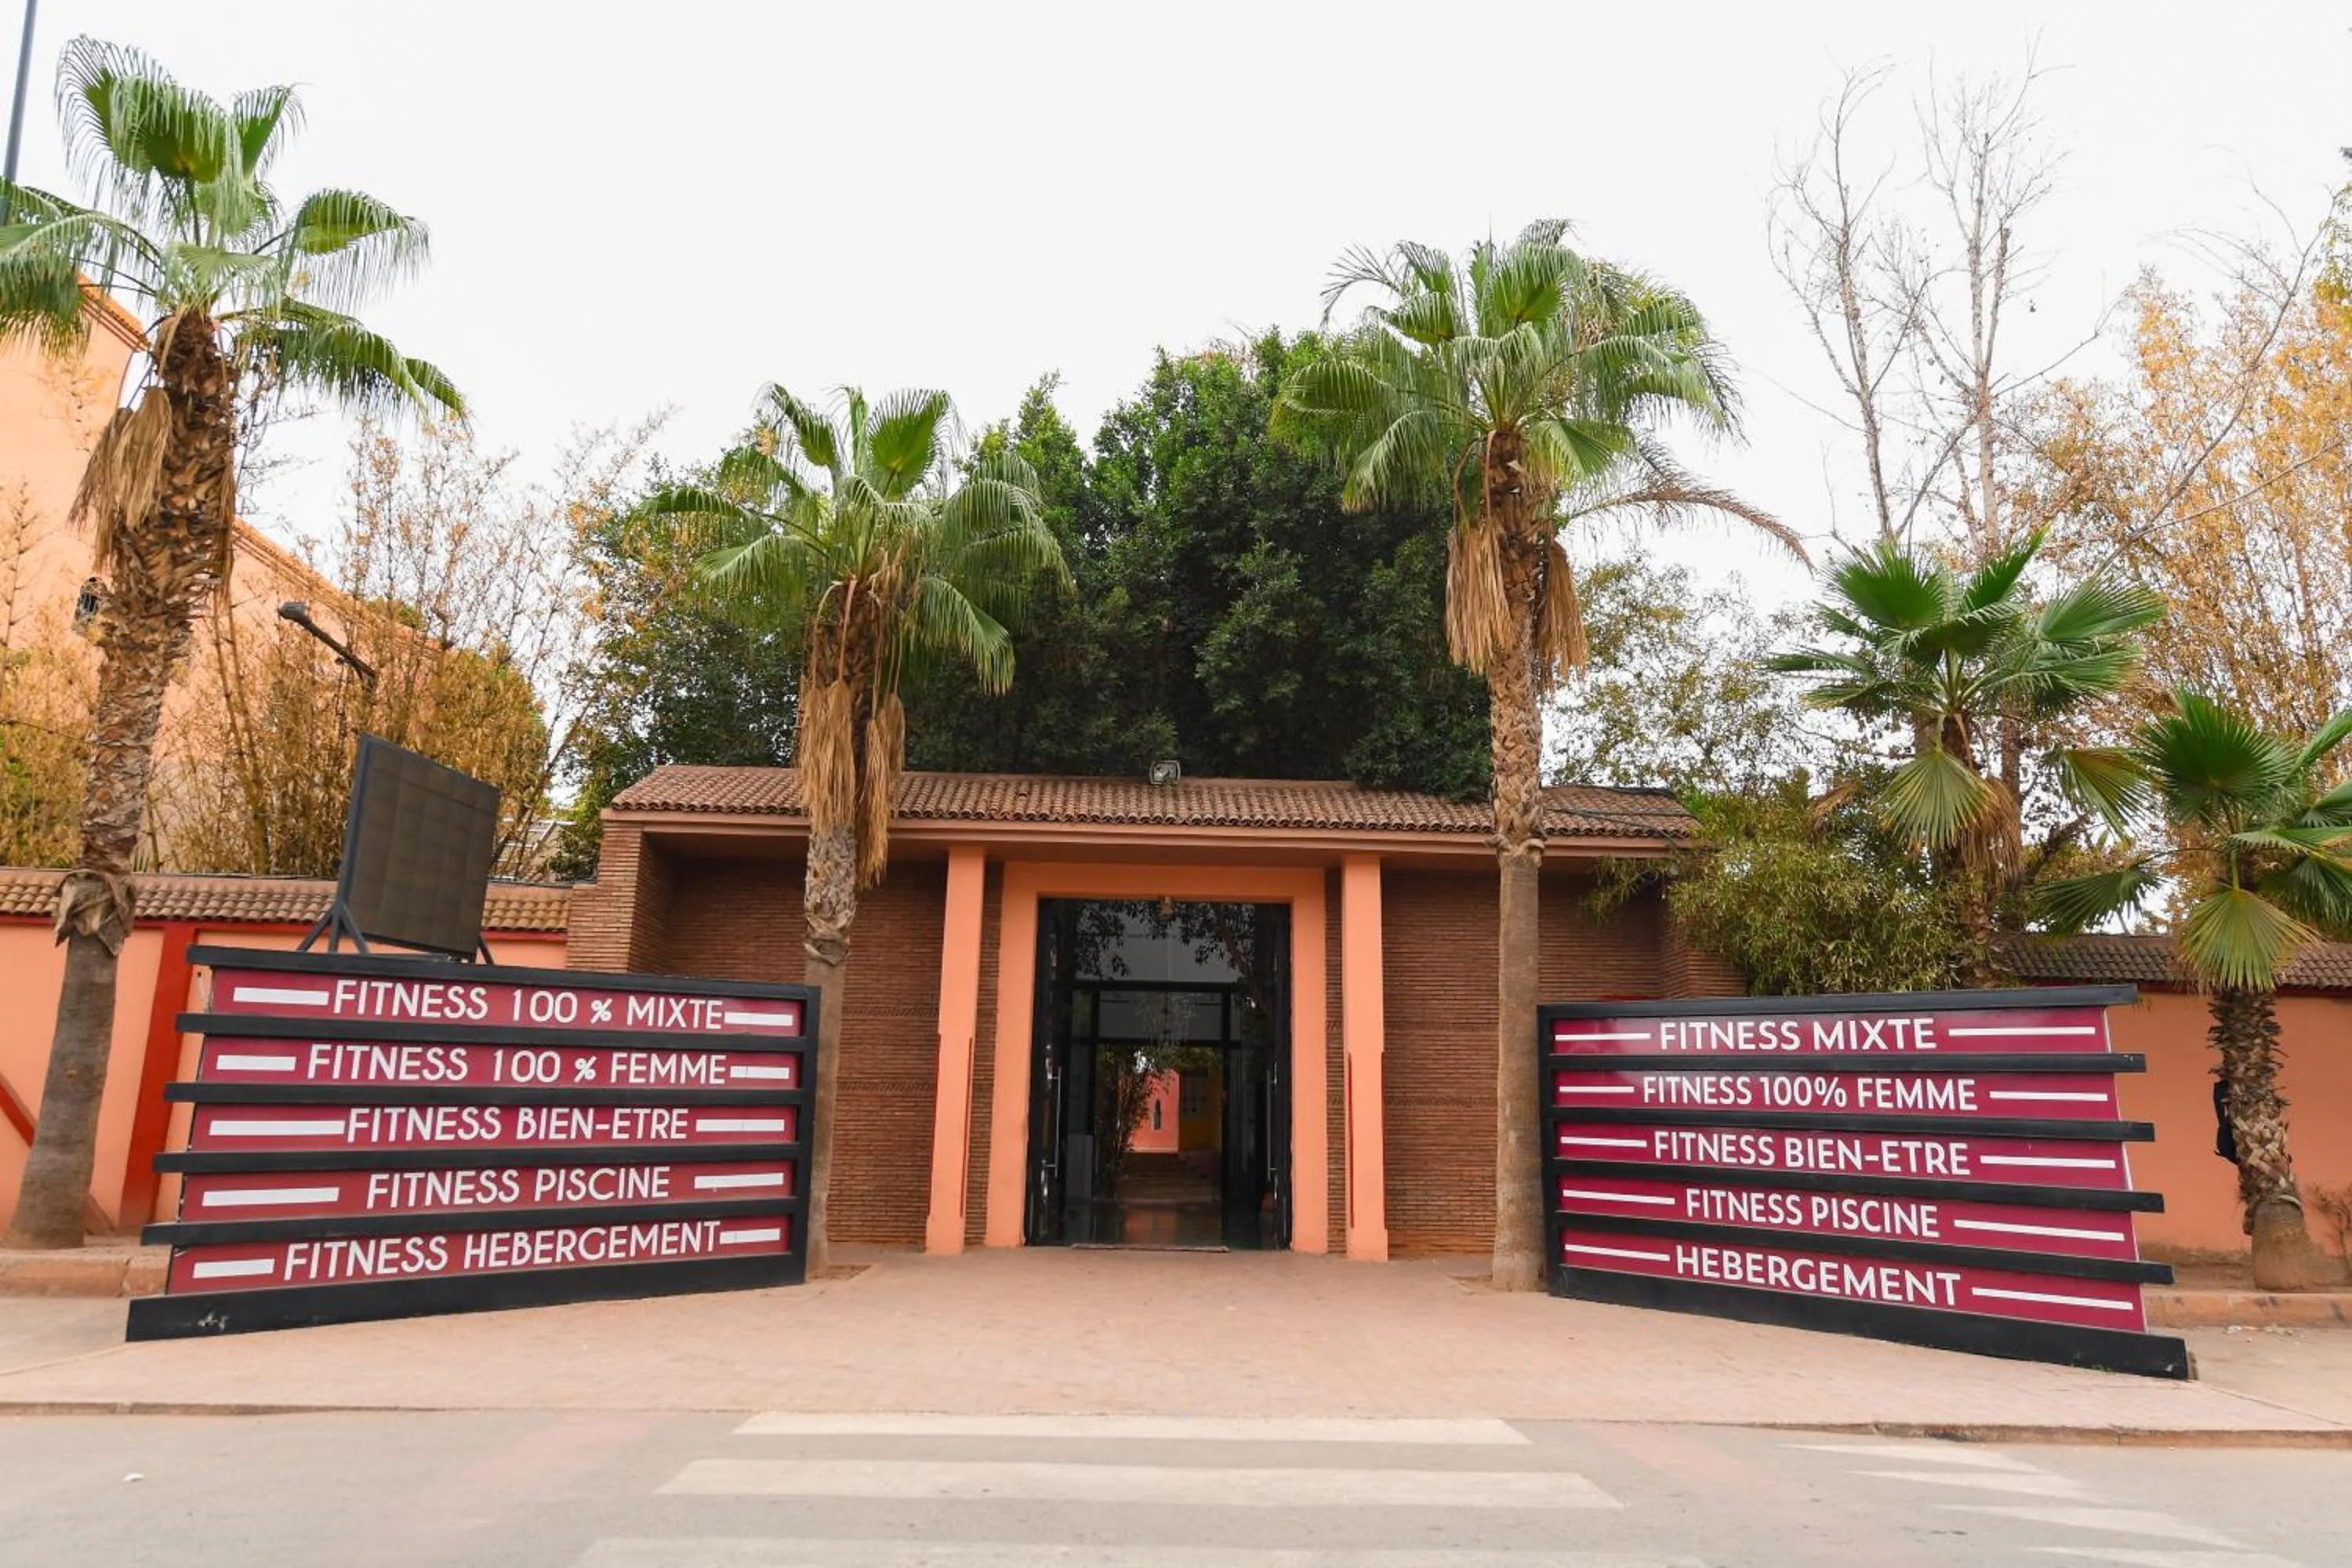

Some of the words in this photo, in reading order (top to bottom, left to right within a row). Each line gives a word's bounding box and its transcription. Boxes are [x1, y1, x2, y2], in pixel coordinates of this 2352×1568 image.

[334, 980, 488, 1020] FITNESS
[514, 989, 577, 1023] 100
[590, 998, 612, 1024] %
[627, 996, 723, 1029] MIXTE
[1660, 1019, 1800, 1051] FITNESS
[1813, 1018, 1936, 1051] MIXTE
[307, 1044, 468, 1080] FITNESS
[494, 1050, 561, 1083] 100
[574, 1056, 596, 1083] %
[611, 1053, 726, 1084] FEMME
[1642, 1074, 1751, 1105] FITNESS
[1759, 1076, 1847, 1107] 100%
[1858, 1078, 1977, 1110] FEMME
[348, 1107, 502, 1142] FITNESS
[517, 1108, 688, 1139] BIEN-ETRE
[1655, 1131, 1775, 1166] FITNESS
[1785, 1138, 1970, 1174] BIEN-ETRE
[367, 1170, 519, 1209] FITNESS
[535, 1167, 670, 1201] PISCINE
[1687, 1189, 1802, 1225] FITNESS
[1812, 1196, 1940, 1237] PISCINE
[285, 1236, 448, 1280] FITNESS
[464, 1221, 720, 1269] HEBERGEMENT
[1675, 1245, 1960, 1305] HEBERGEMENT
